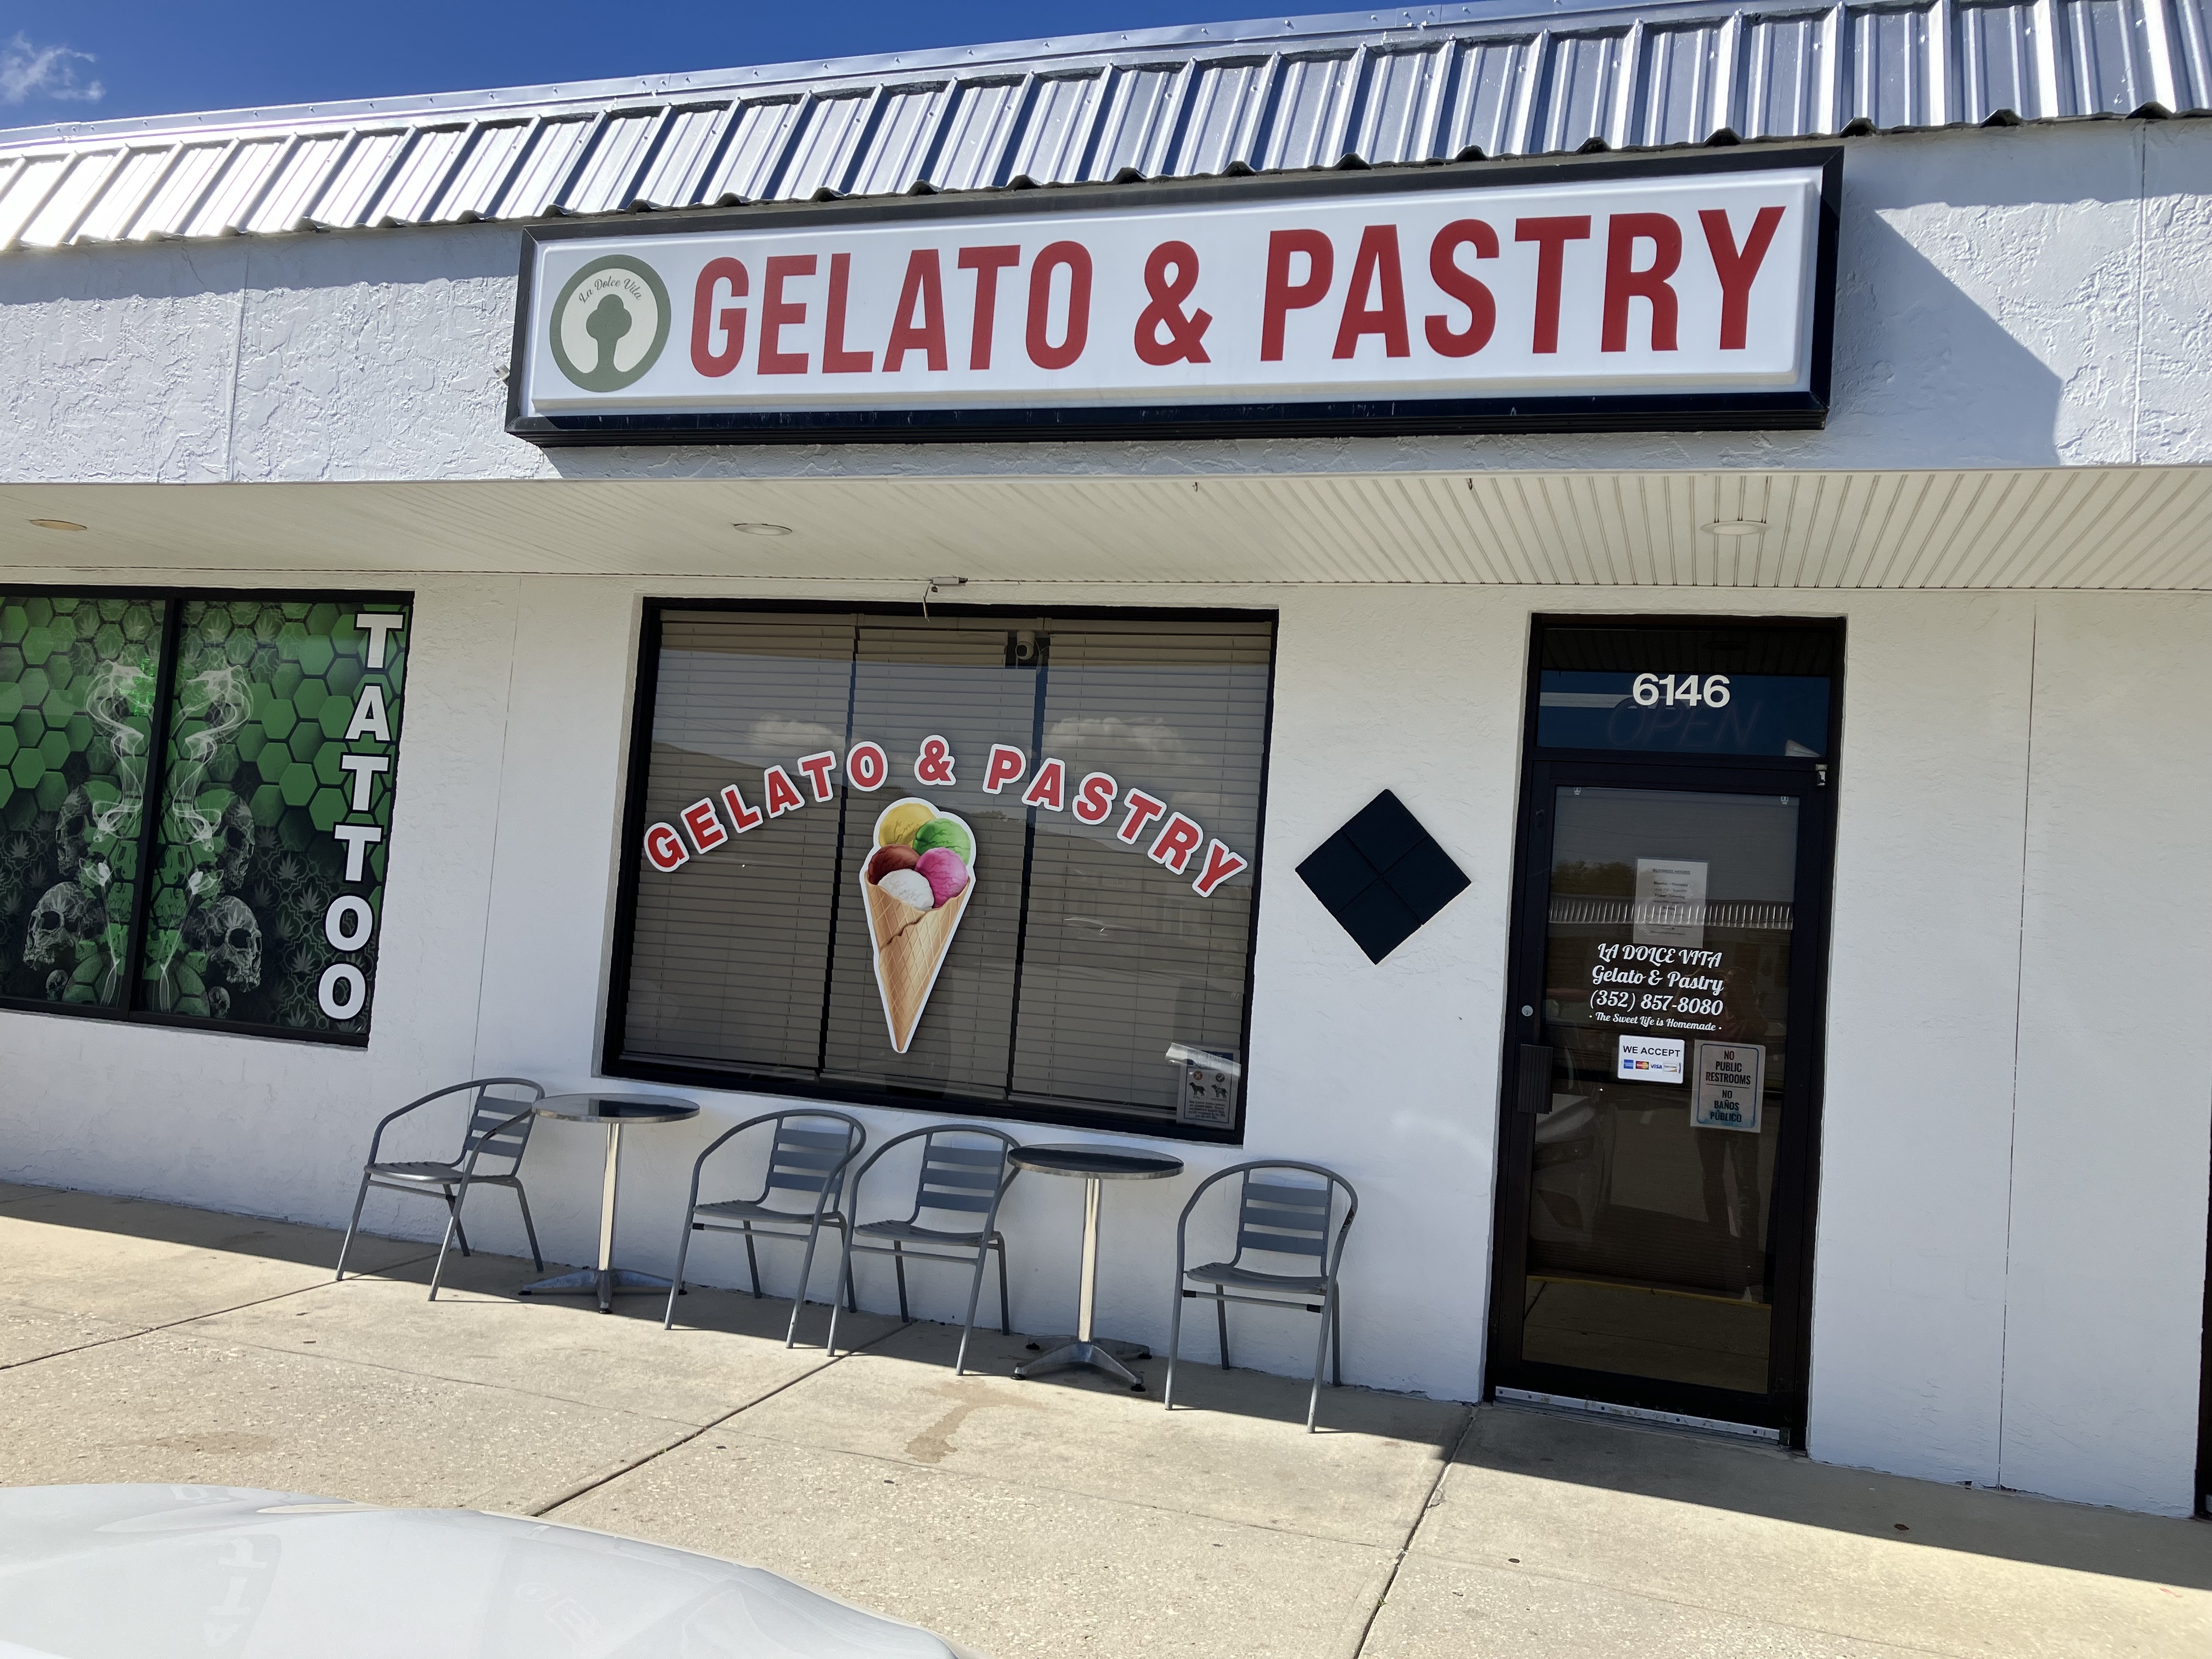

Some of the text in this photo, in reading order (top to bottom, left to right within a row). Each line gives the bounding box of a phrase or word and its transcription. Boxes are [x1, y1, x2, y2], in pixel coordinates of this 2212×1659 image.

[579, 275, 642, 303] La Dolce Vita
[692, 208, 1784, 377] GELATO & PASTRY
[1633, 673, 1730, 708] 6146
[318, 613, 404, 1020] TATTOO
[646, 738, 1244, 894] GELATO & PASTRY
[1598, 943, 1723, 969] LA DOLCE VITA
[1592, 965, 1724, 996] Gelato & Pastry
[1590, 990, 1724, 1015] (352) 857-8080
[1595, 1012, 1716, 1031] The Sweet Life is Homemade
[1623, 1045, 1681, 1057] WE ACCEPT
[1724, 1050, 1735, 1060] NO
[1716, 1060, 1742, 1072] PUBLIC
[1706, 1071, 1751, 1085] RESTROOMS
[1714, 1099, 1740, 1110] BAÑOS
[1722, 1090, 1733, 1098] NO
[1710, 1110, 1742, 1122] PÚBLICO
